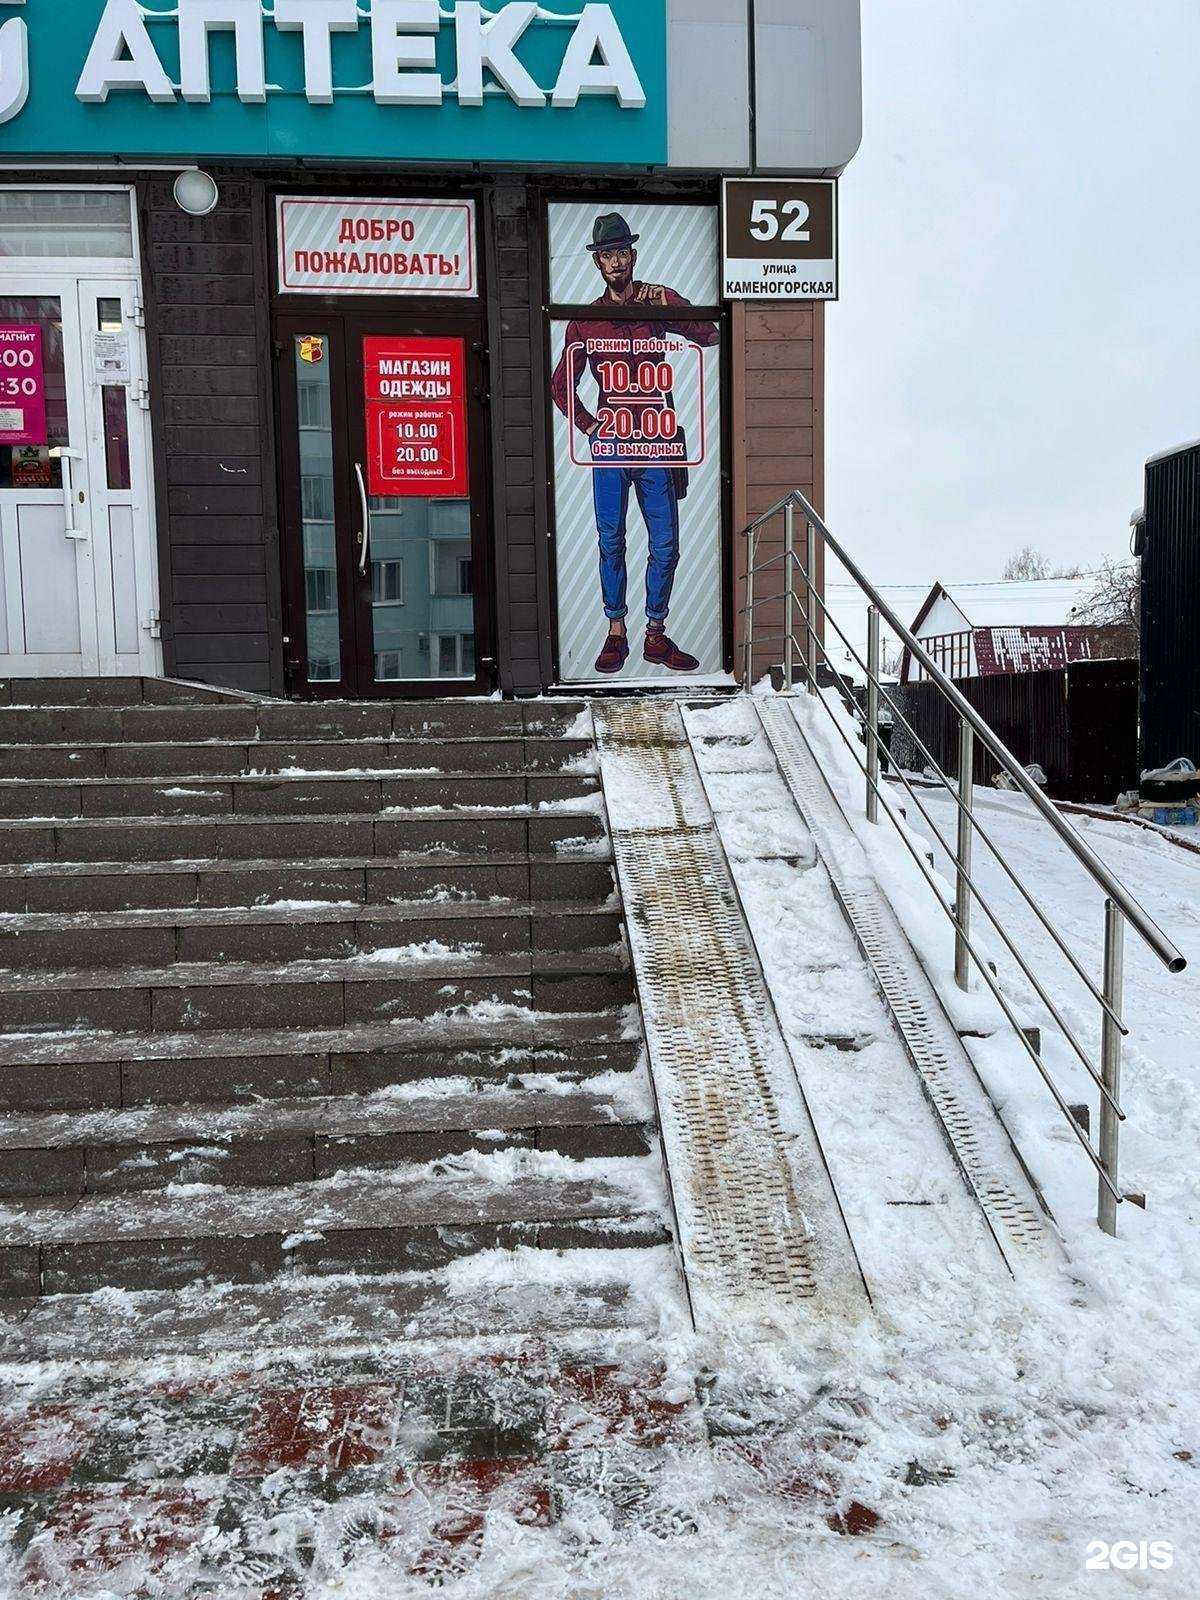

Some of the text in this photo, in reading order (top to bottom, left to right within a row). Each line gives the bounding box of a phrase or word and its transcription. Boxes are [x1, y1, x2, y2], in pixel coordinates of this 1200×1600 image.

[75, 0, 647, 108] АПТЕКА
[749, 200, 810, 241] 52
[339, 218, 415, 244] ДОБРО
[294, 250, 461, 276] ПОЖАЛОВАТЬ!
[762, 264, 797, 276] улица
[726, 281, 833, 294] КАМЕНОГОРСКАЯ
[587, 338, 685, 355] режим работы:
[378, 359, 451, 376] МАГАЗИН
[597, 361, 675, 393] 10.00
[379, 379, 452, 398] ОДЕЖДЫ
[388, 410, 444, 419] режим работы:
[396, 423, 438, 438] 10.00
[597, 407, 678, 440] 20.00
[396, 447, 439, 462] 20.00
[592, 441, 684, 458] без выходных
[391, 466, 443, 476] без выходных
